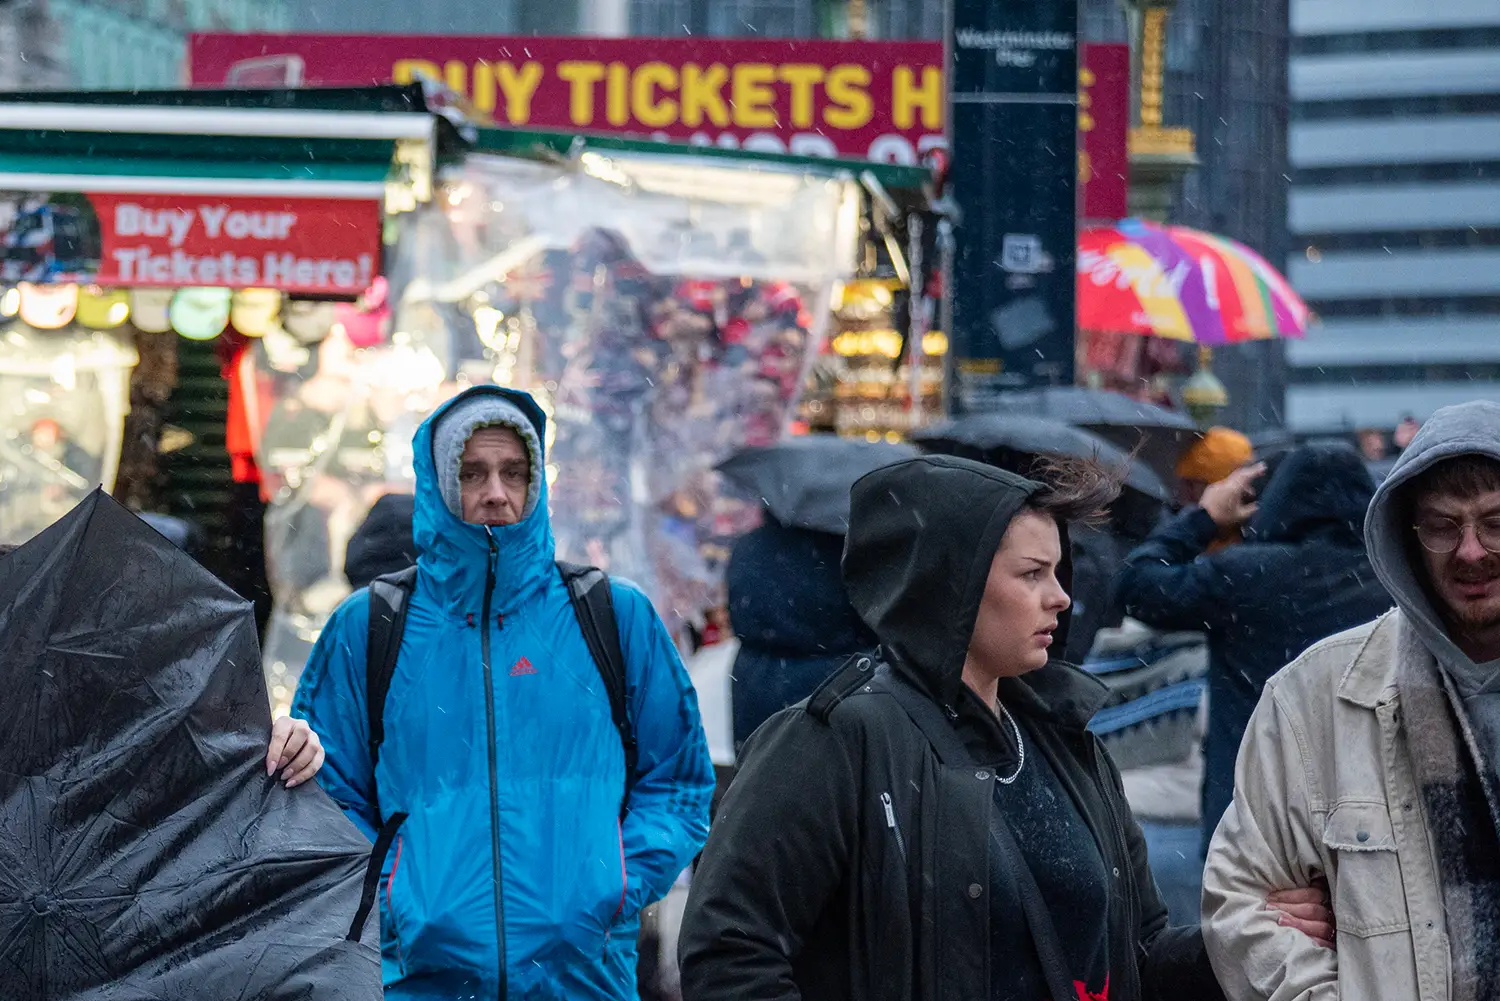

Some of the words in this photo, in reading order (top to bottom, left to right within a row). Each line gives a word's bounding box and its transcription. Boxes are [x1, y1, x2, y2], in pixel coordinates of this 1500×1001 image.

[556, 60, 874, 130] TICKETS
[115, 203, 194, 247] Buy
[200, 204, 297, 239] Your
[113, 246, 258, 284] Tickets
[263, 252, 373, 287] Here!
